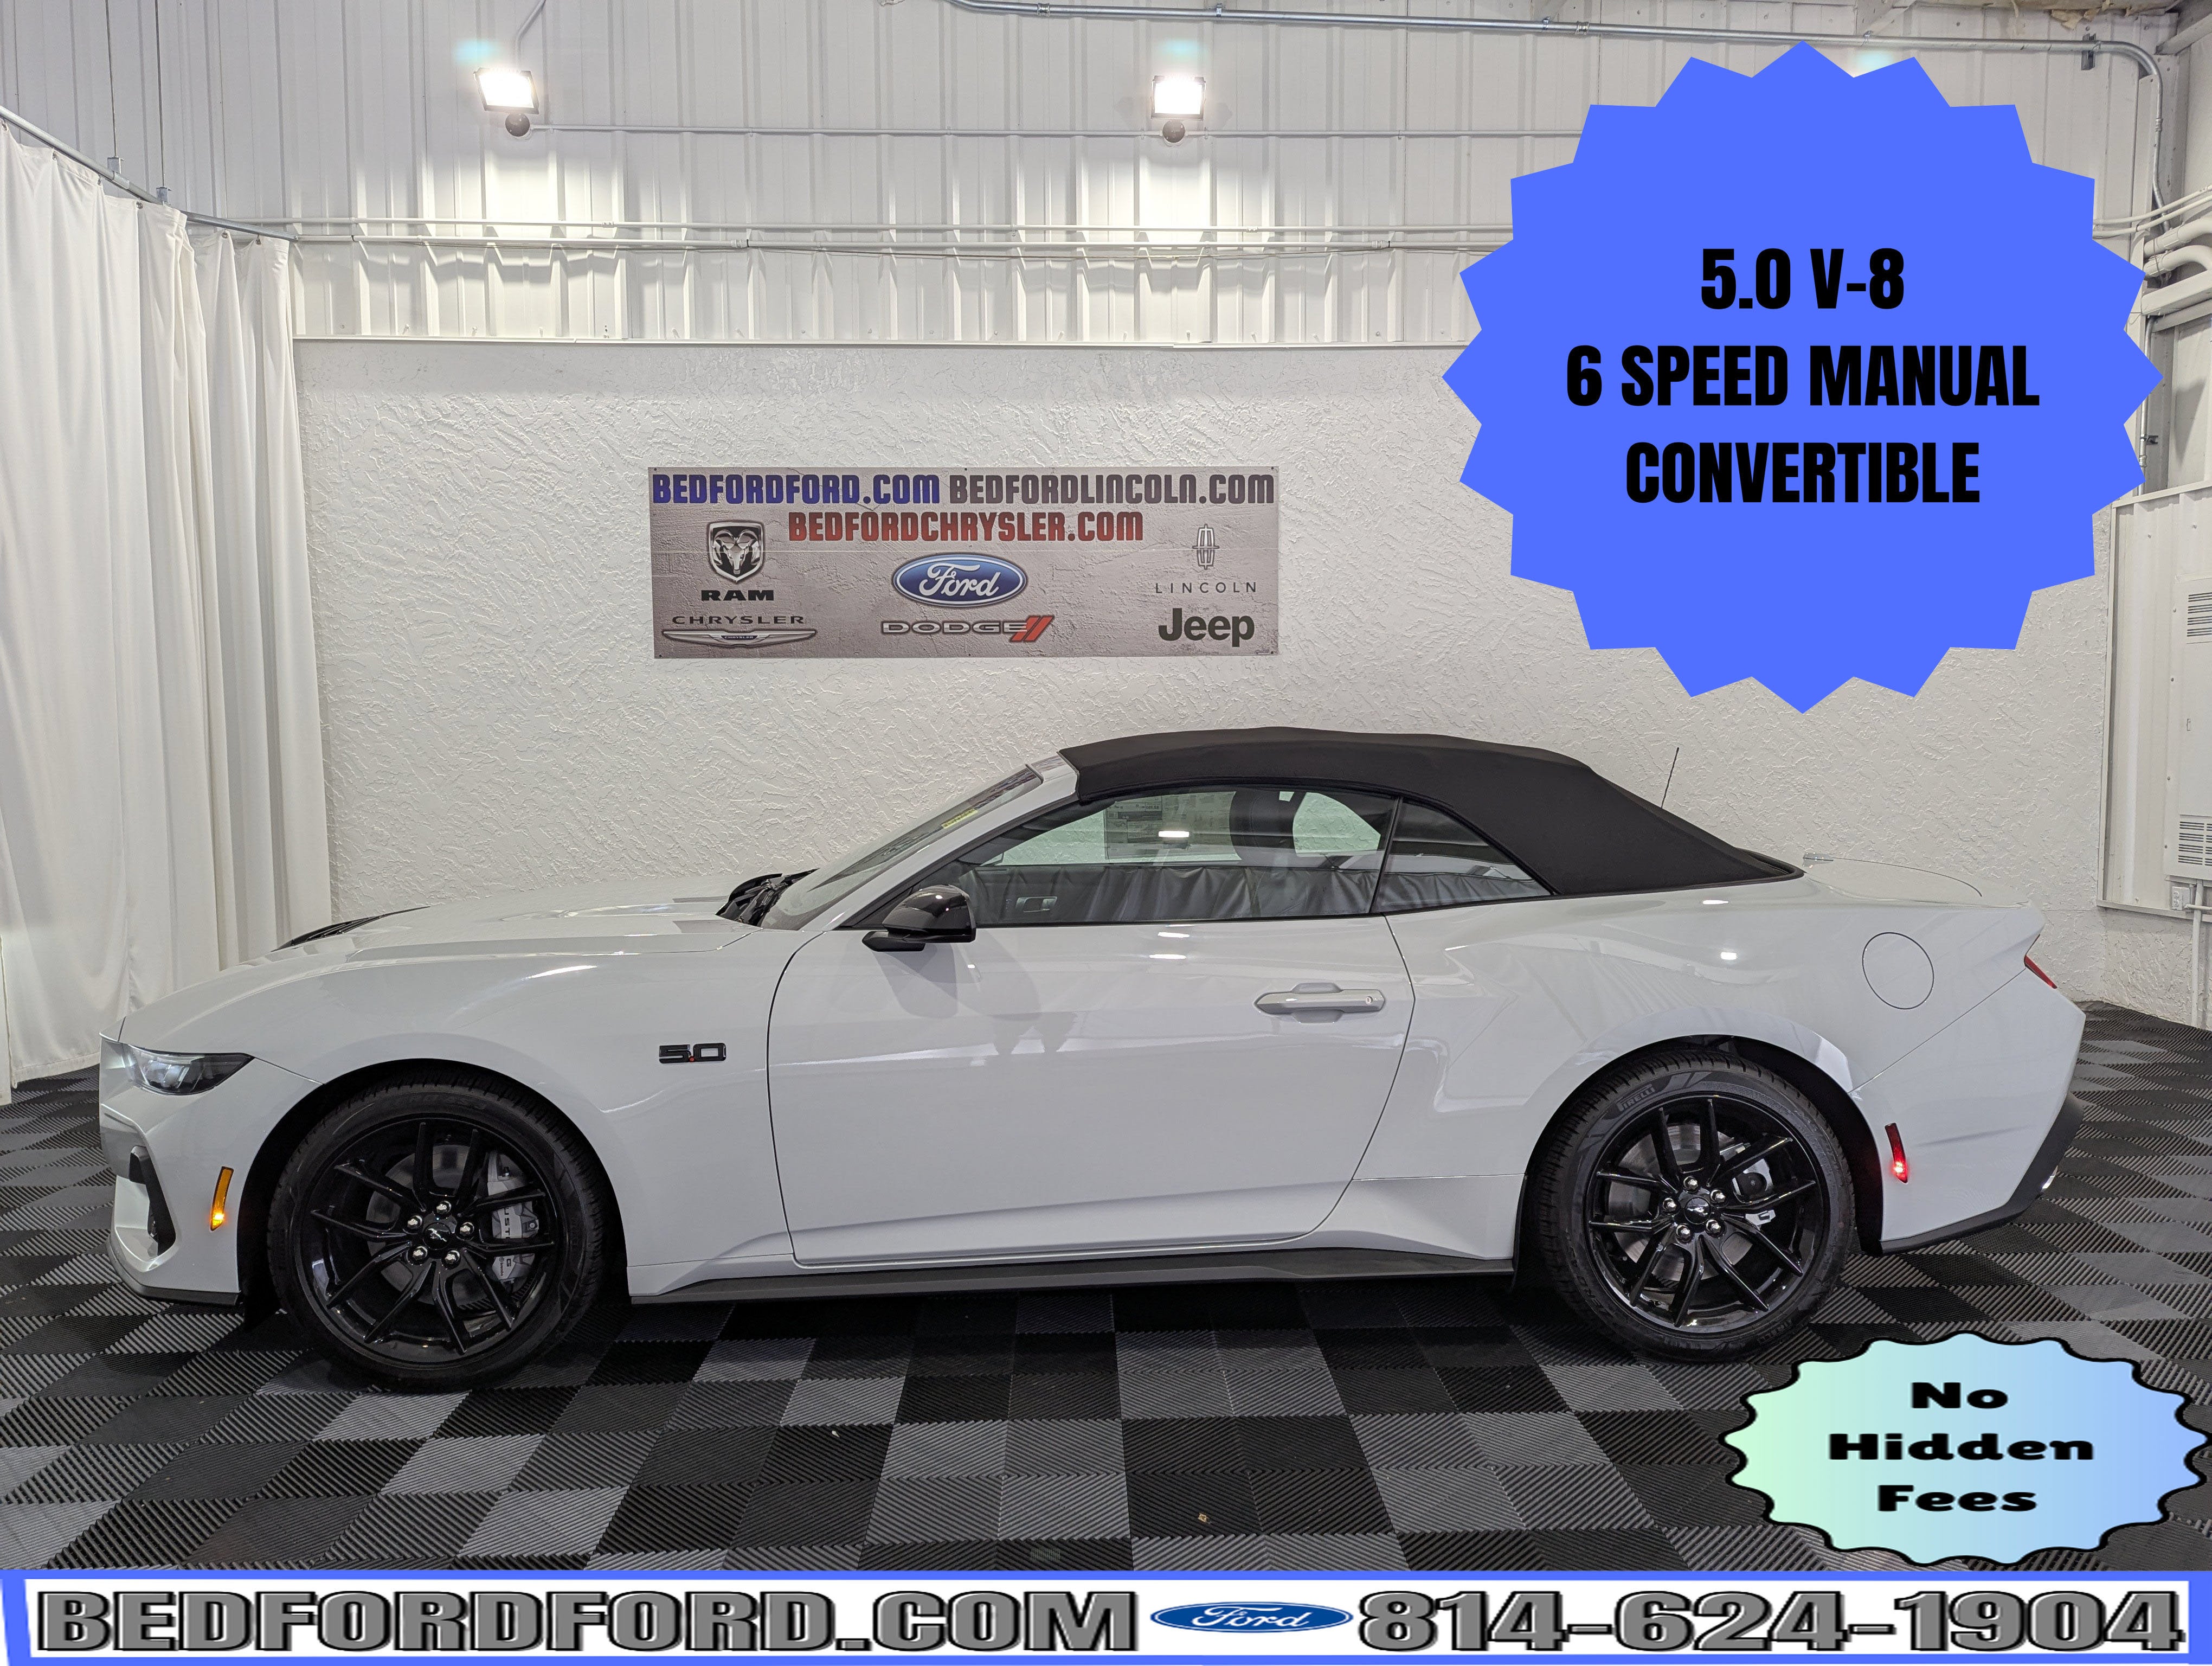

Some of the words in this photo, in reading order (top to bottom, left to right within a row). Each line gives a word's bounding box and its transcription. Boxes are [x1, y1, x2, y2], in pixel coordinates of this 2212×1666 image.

[652, 474, 940, 504] BEDFORDFORD.COM
[949, 474, 1275, 504] BEDFORDLINCOLN.COM
[788, 511, 1143, 542] BEDFORDCHRYSLER.COM
[919, 562, 1001, 597] Ford
[1155, 581, 1256, 594] LINCOLN
[701, 589, 774, 601] RAM
[672, 616, 804, 624] CHRYSLER
[882, 620, 1028, 634] DODGE
[1158, 607, 1255, 647] Jeep
[659, 1042, 727, 1064] 5.0
[1616, 1084, 1655, 1112] PIRELLI
